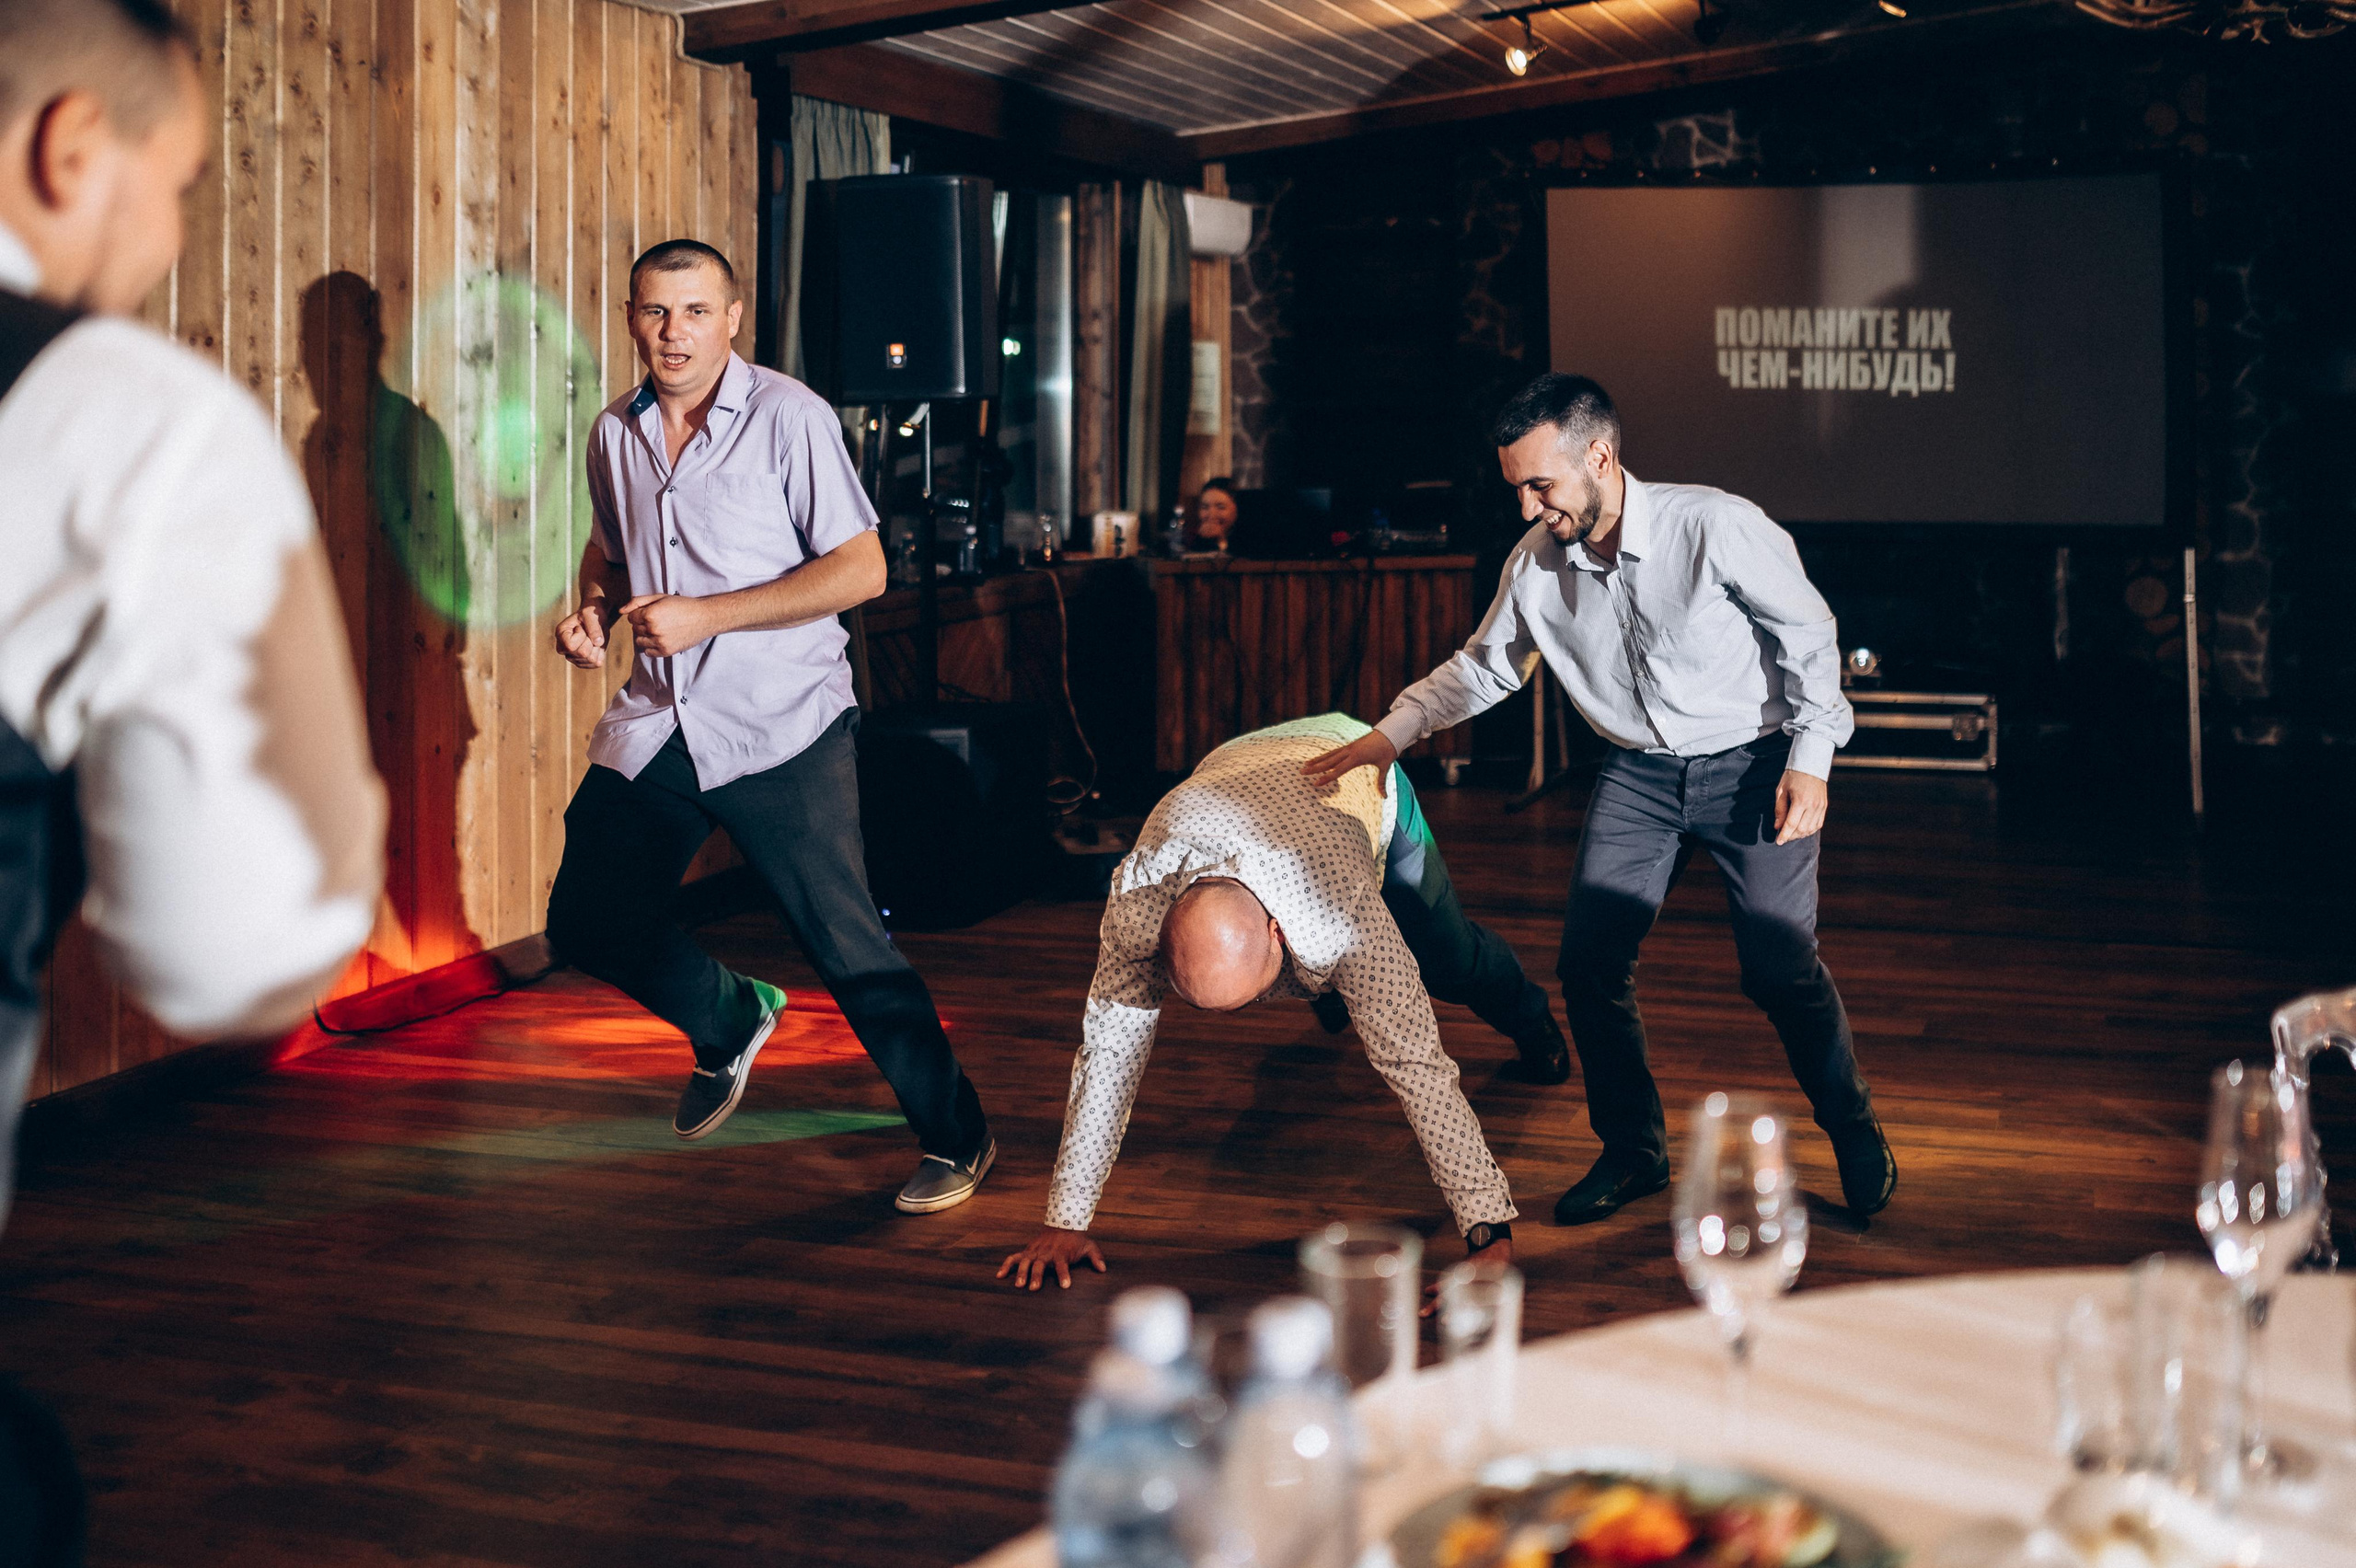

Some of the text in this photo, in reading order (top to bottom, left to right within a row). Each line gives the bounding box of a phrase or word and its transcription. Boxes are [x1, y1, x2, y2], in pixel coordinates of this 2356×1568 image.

[1715, 307, 1952, 350] ПОМАНИТЕ ИХ
[1717, 350, 1957, 398] ЧЕМ-НИБУДЬ!
